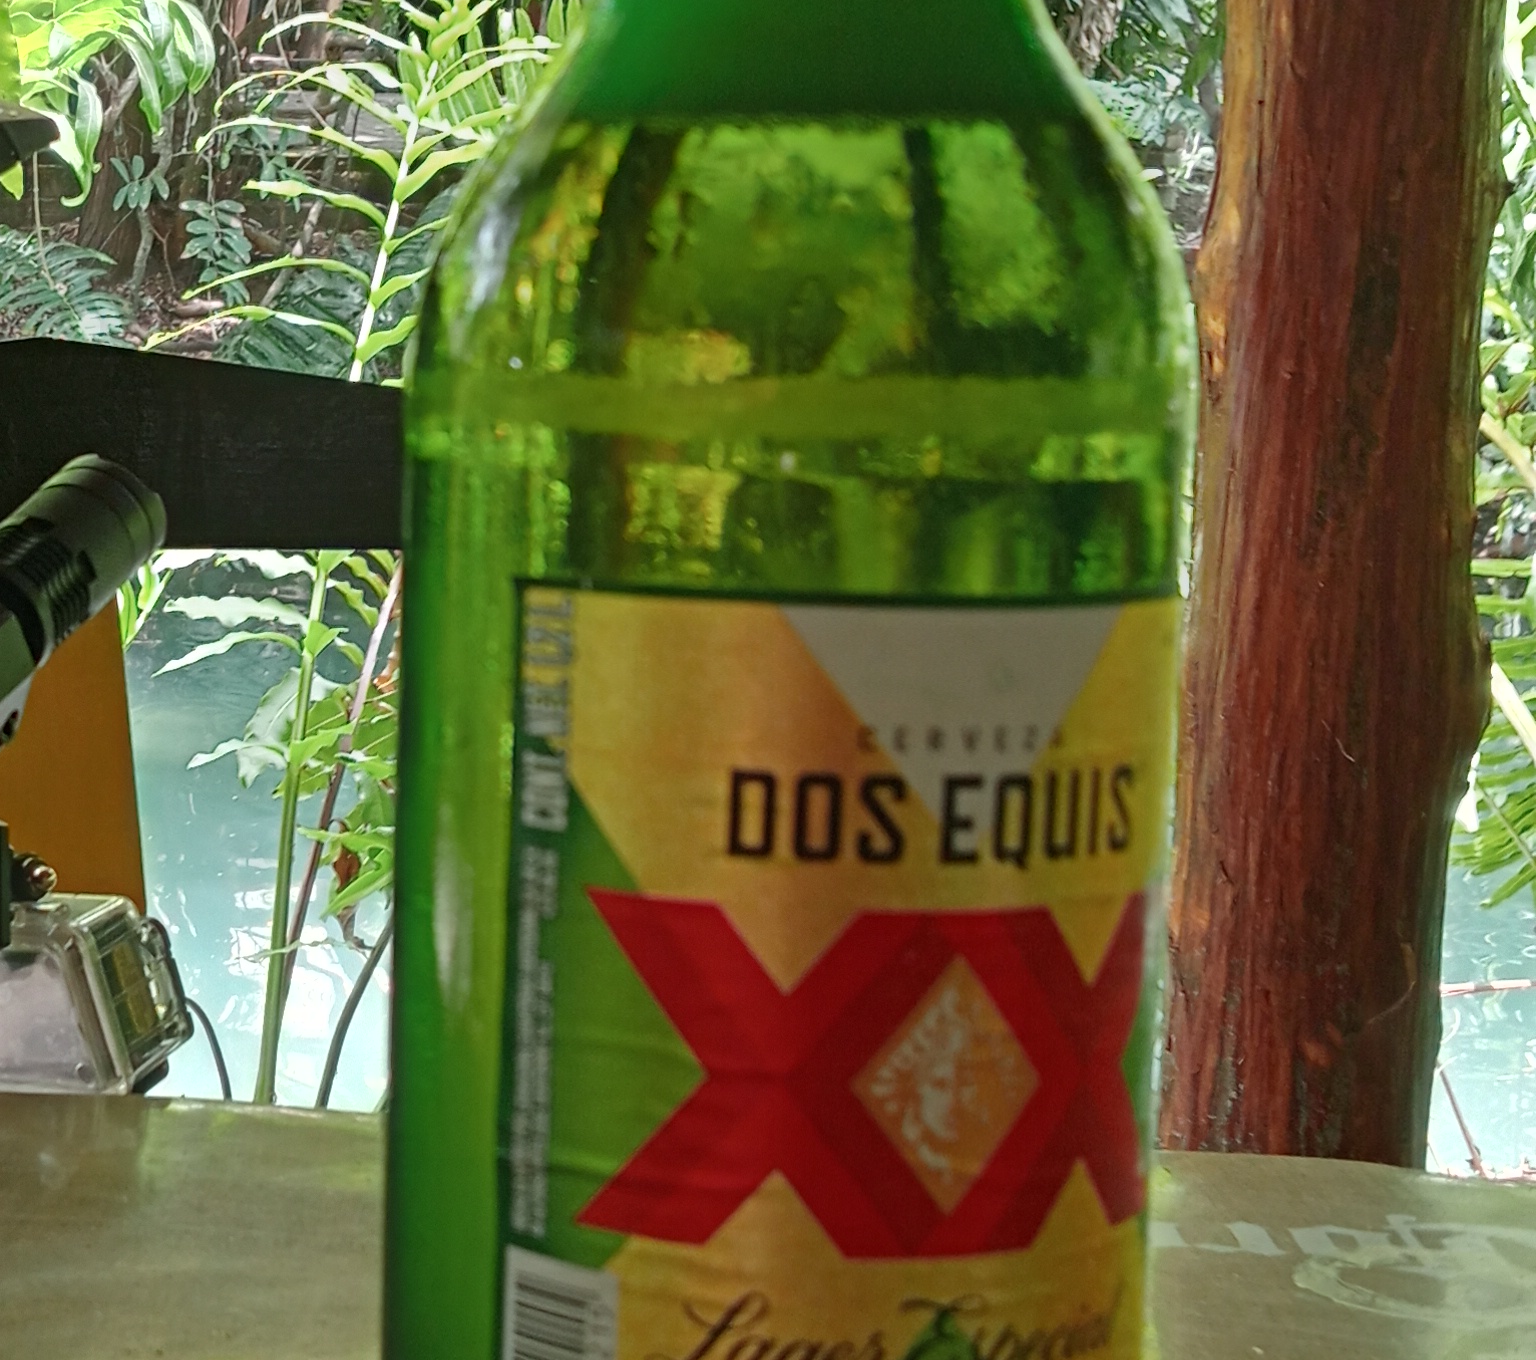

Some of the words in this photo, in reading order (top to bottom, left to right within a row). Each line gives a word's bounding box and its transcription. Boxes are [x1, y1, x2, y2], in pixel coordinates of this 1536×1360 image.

[856, 723, 1066, 753] CERVEZA
[727, 768, 907, 864] DOS
[939, 761, 1135, 870] EQUIS
[576, 885, 1146, 1261] XX
